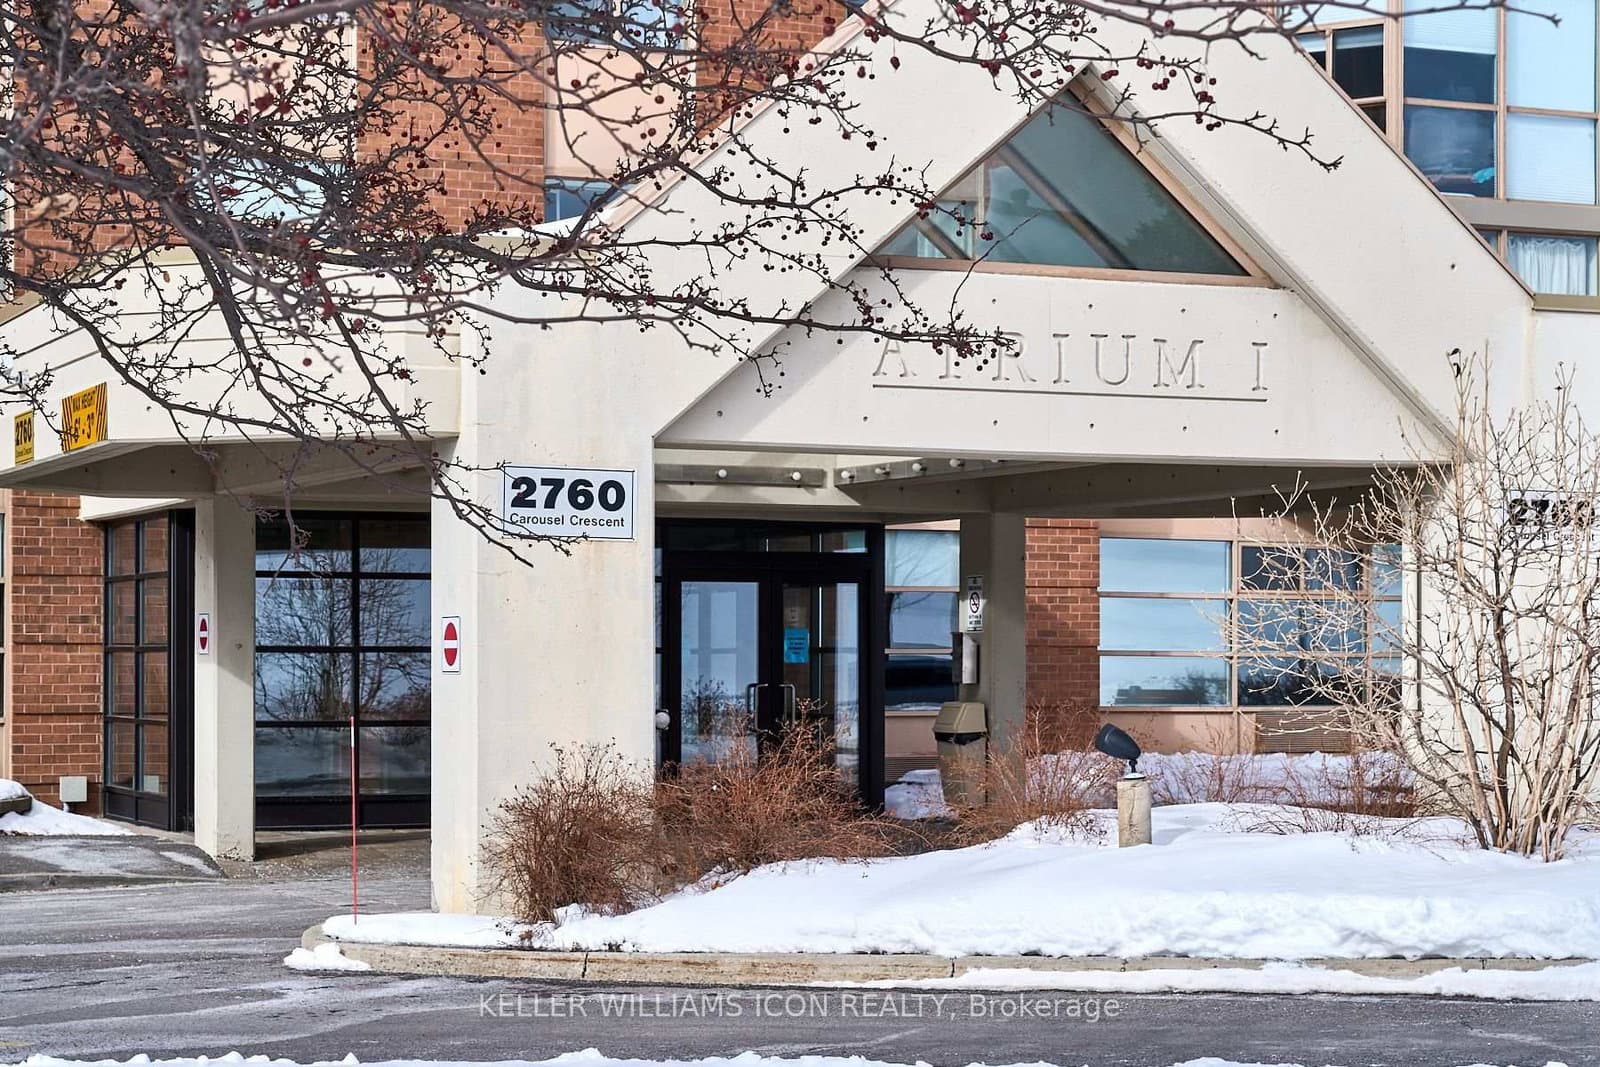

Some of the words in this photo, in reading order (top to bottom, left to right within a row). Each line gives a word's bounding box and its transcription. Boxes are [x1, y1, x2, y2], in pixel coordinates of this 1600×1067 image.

[873, 325, 1205, 388] ATRIUM
[1252, 341, 1268, 390] I
[15, 417, 32, 446] 2760
[510, 476, 625, 512] 2760
[510, 513, 564, 526] Carousel
[570, 514, 624, 527] Crescent
